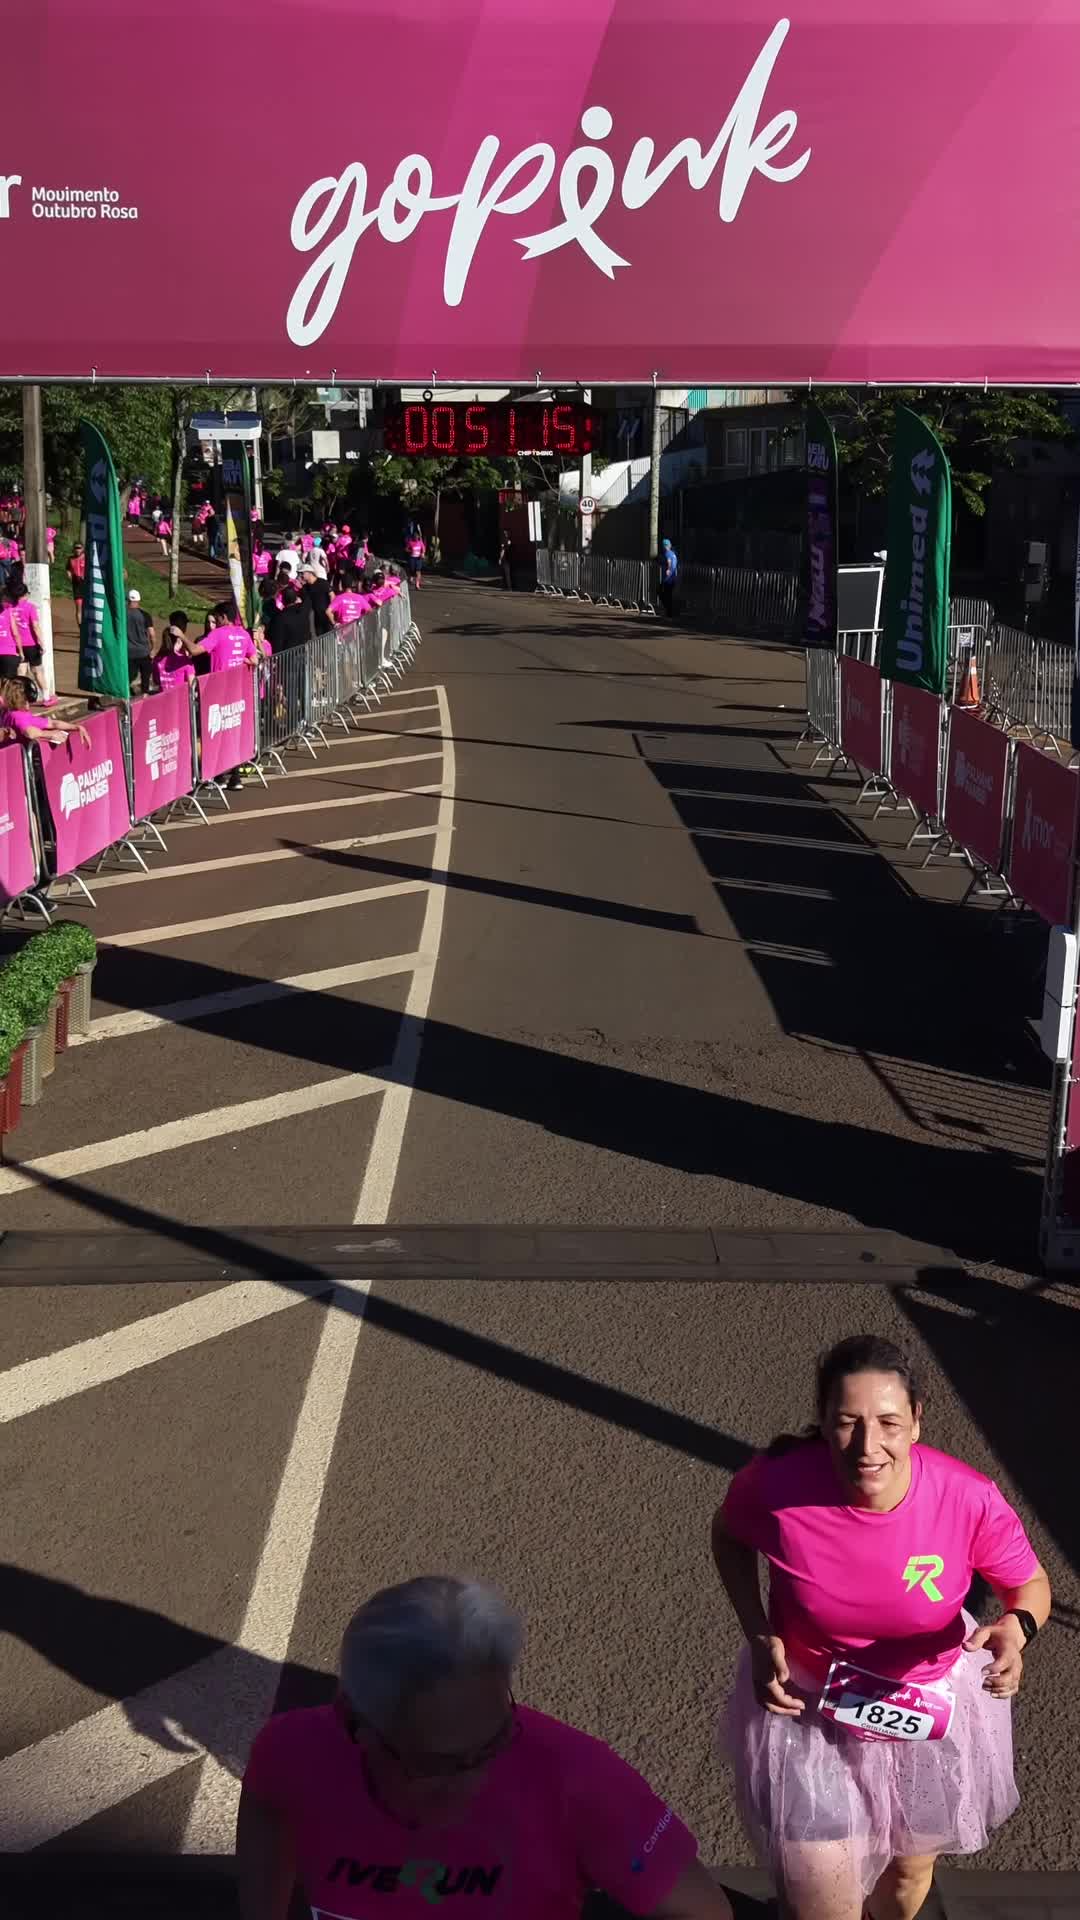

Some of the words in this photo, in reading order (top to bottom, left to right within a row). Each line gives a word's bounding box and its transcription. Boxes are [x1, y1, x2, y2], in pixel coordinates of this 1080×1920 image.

[32, 186, 120, 202] Movimento
[32, 203, 97, 218] Outubro
[100, 204, 138, 218] Rosa
[582, 500, 594, 508] 40
[895, 504, 929, 673] Unimed
[77, 759, 113, 792] PALHANO
[853, 1701, 922, 1735] 1825
